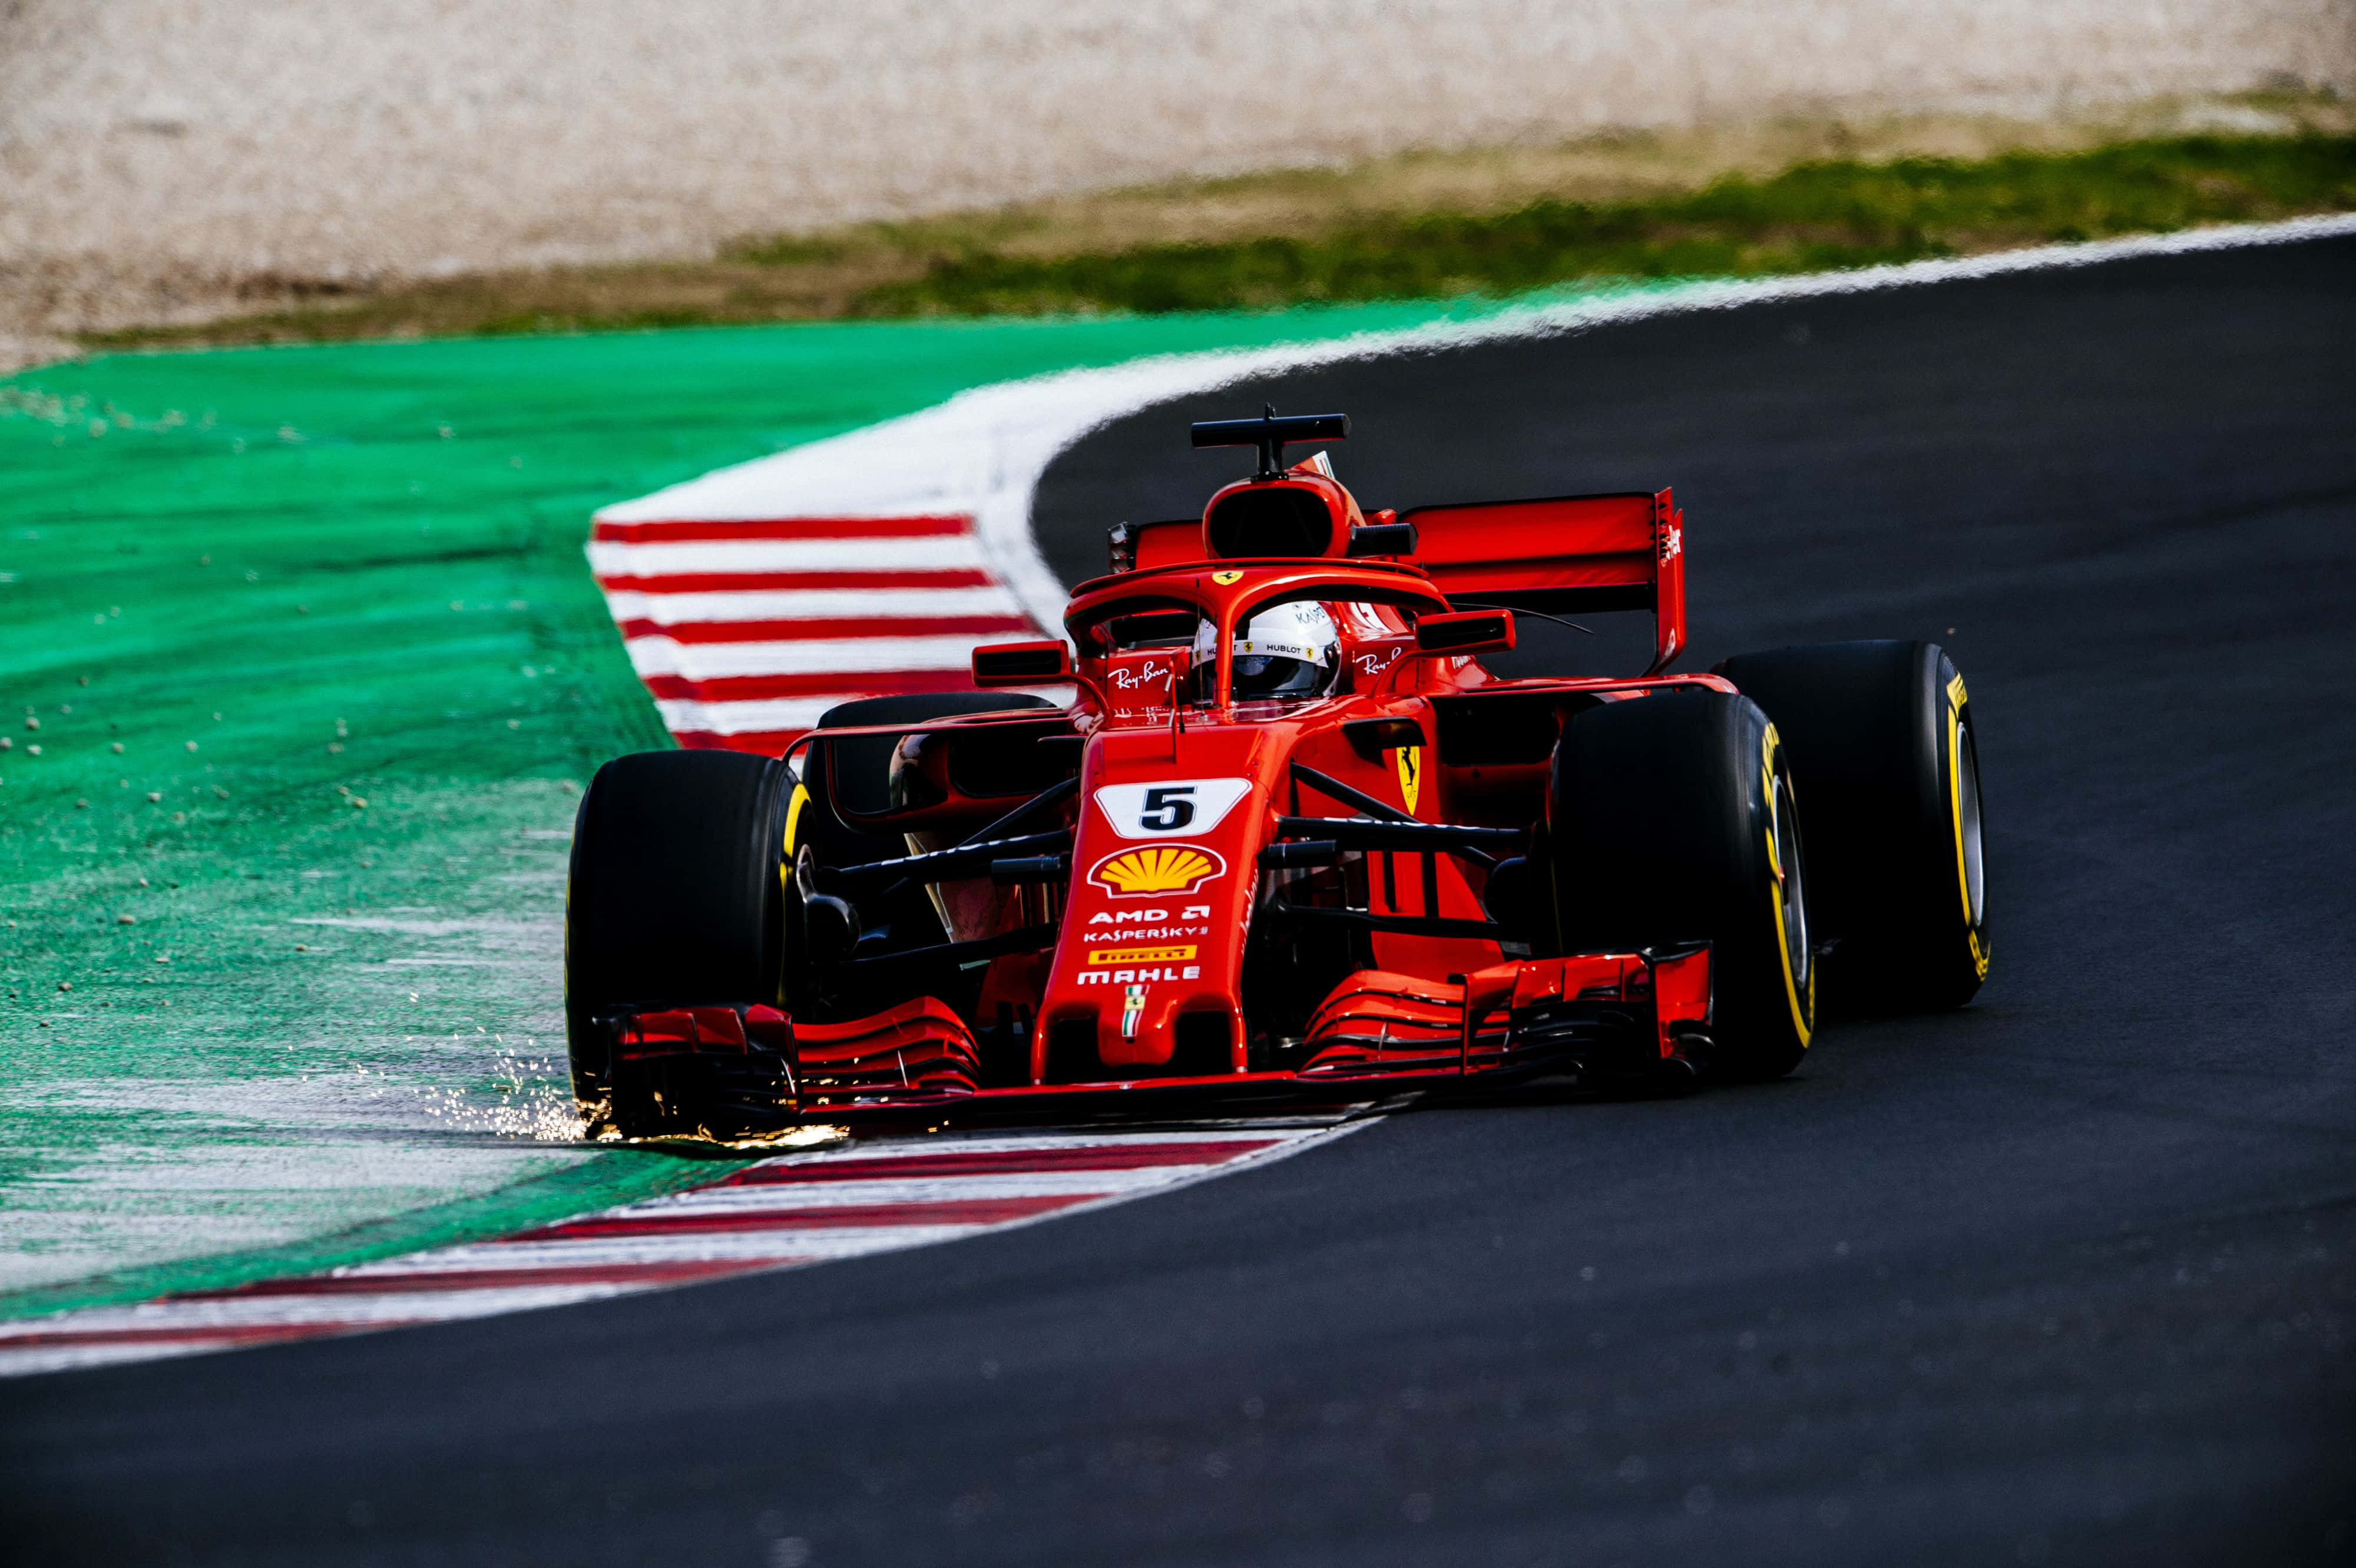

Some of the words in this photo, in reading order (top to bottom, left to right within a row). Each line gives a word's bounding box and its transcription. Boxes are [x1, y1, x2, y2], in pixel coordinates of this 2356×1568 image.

[1266, 644, 1301, 654] HUBLOT
[1107, 660, 1169, 689] Ray-Ban
[1139, 786, 1198, 831] 5
[1088, 909, 1169, 924] AMD
[1083, 927, 1197, 942] KASPERSKY
[1077, 965, 1200, 985] MAHLE
